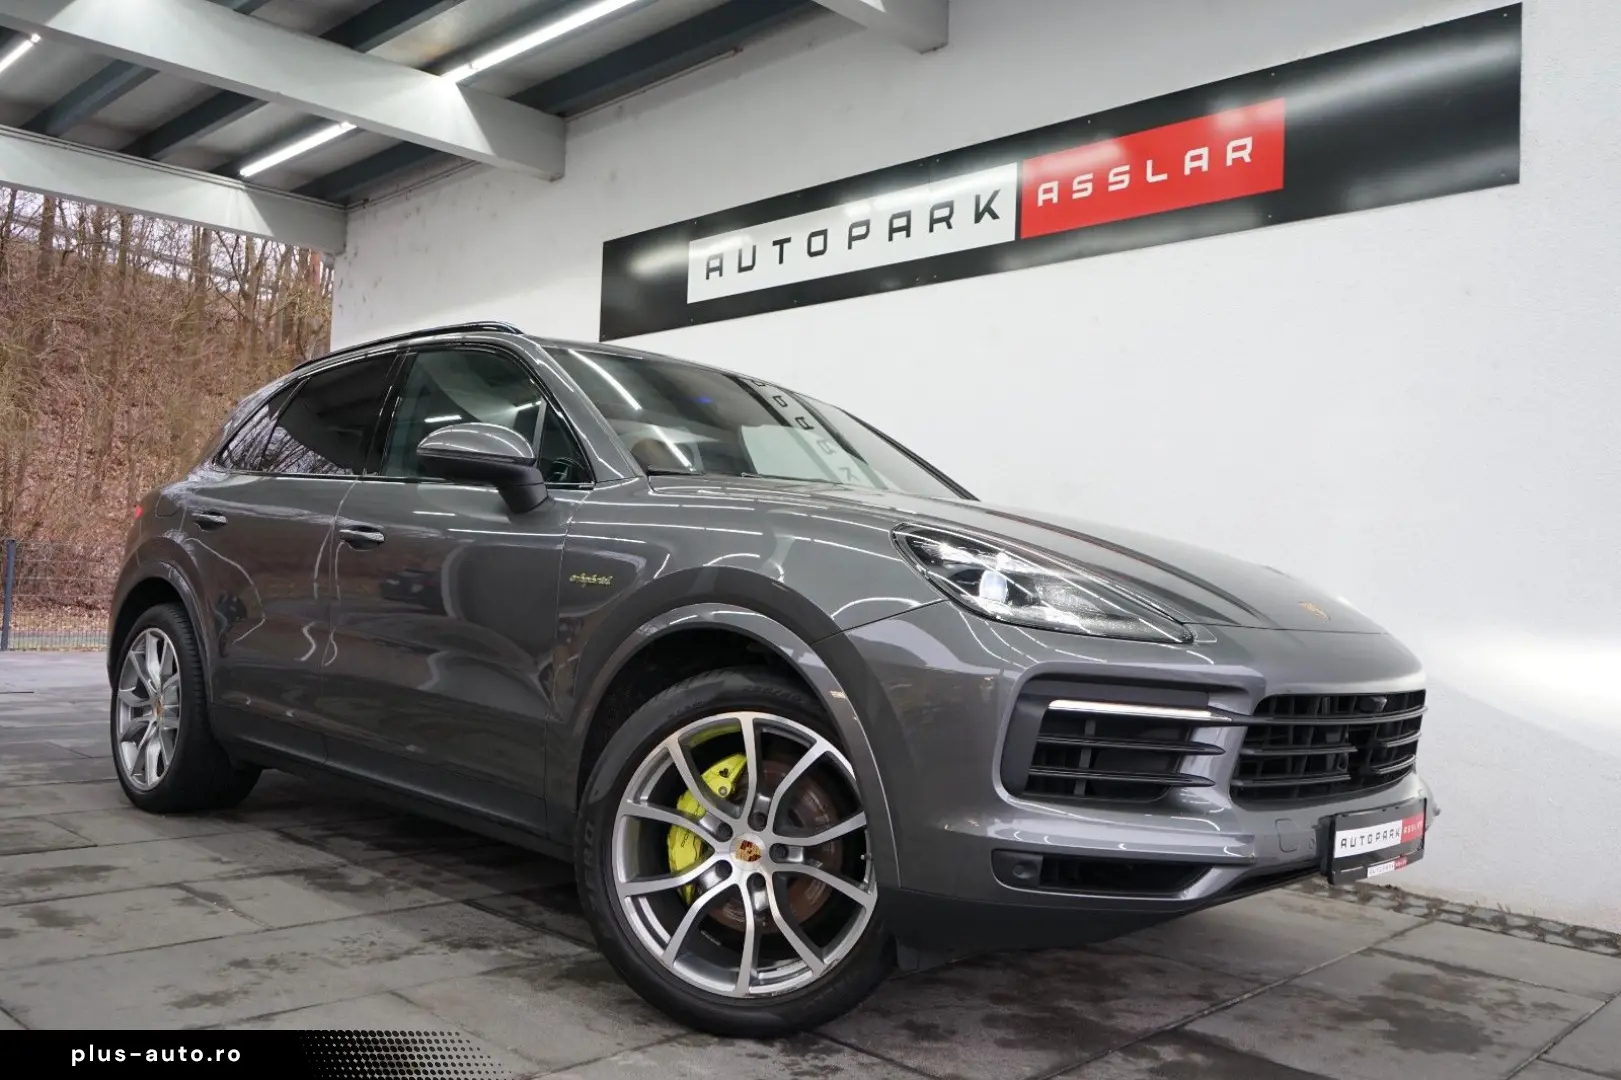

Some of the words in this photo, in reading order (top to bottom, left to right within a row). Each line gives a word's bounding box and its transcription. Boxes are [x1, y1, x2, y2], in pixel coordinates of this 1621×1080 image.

[705, 188, 1001, 280] AUTOPARK
[1037, 136, 1253, 207] ASSLAR
[1340, 828, 1400, 849] AUTOPARK
